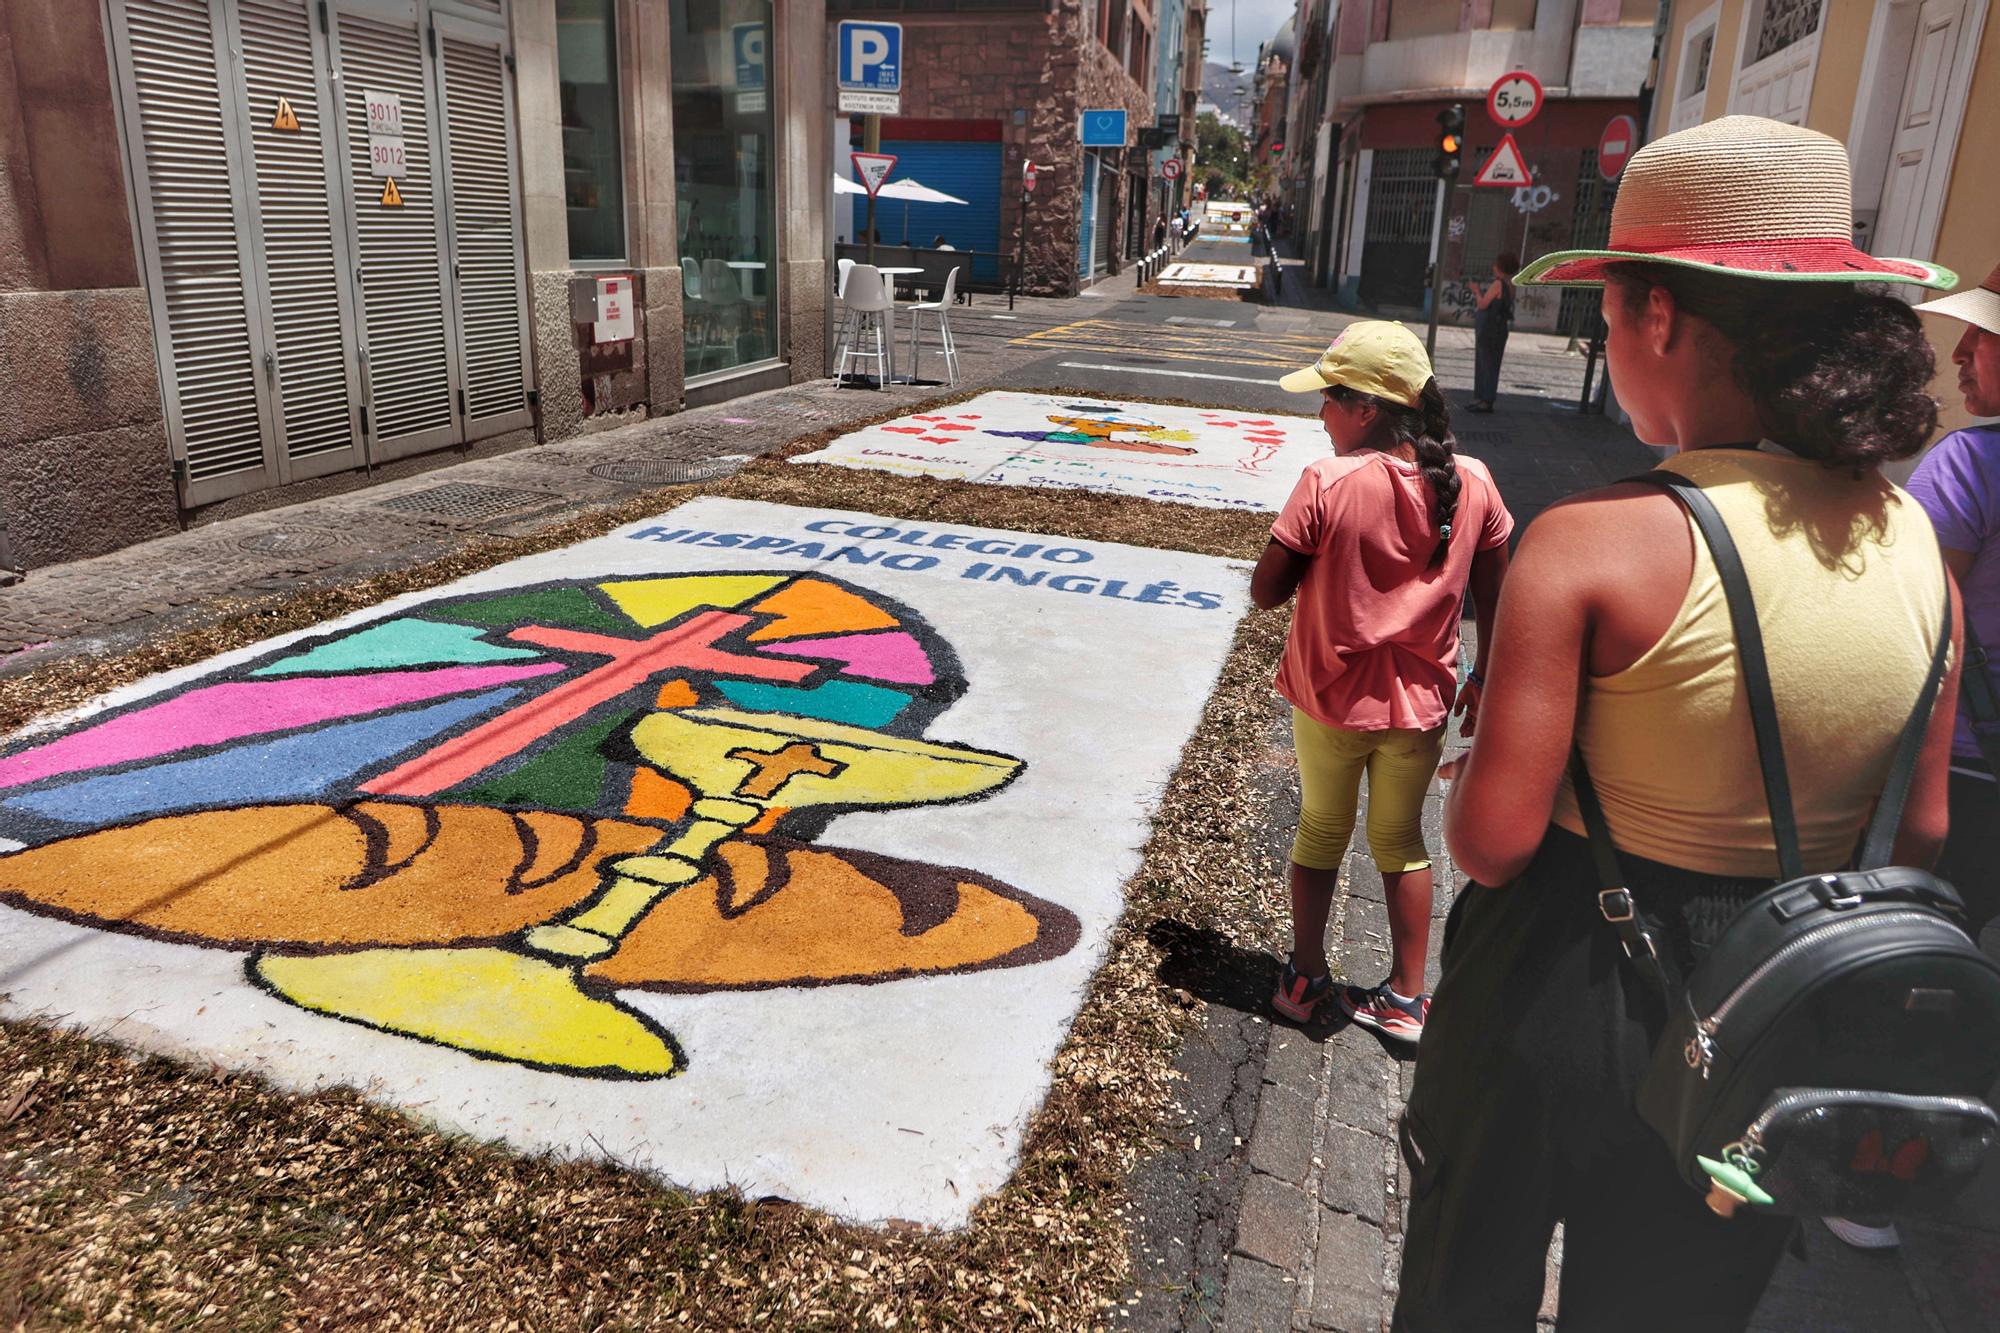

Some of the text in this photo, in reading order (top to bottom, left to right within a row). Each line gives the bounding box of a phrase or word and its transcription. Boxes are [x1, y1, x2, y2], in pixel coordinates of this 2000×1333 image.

[851, 29, 889, 82] P
[369, 103, 398, 121] 3011
[1496, 91, 1532, 108] 5,5m
[374, 146, 403, 164] 3012
[804, 520, 1094, 564] COLEGIO
[625, 526, 1222, 609] HISPANO INGLÉS
